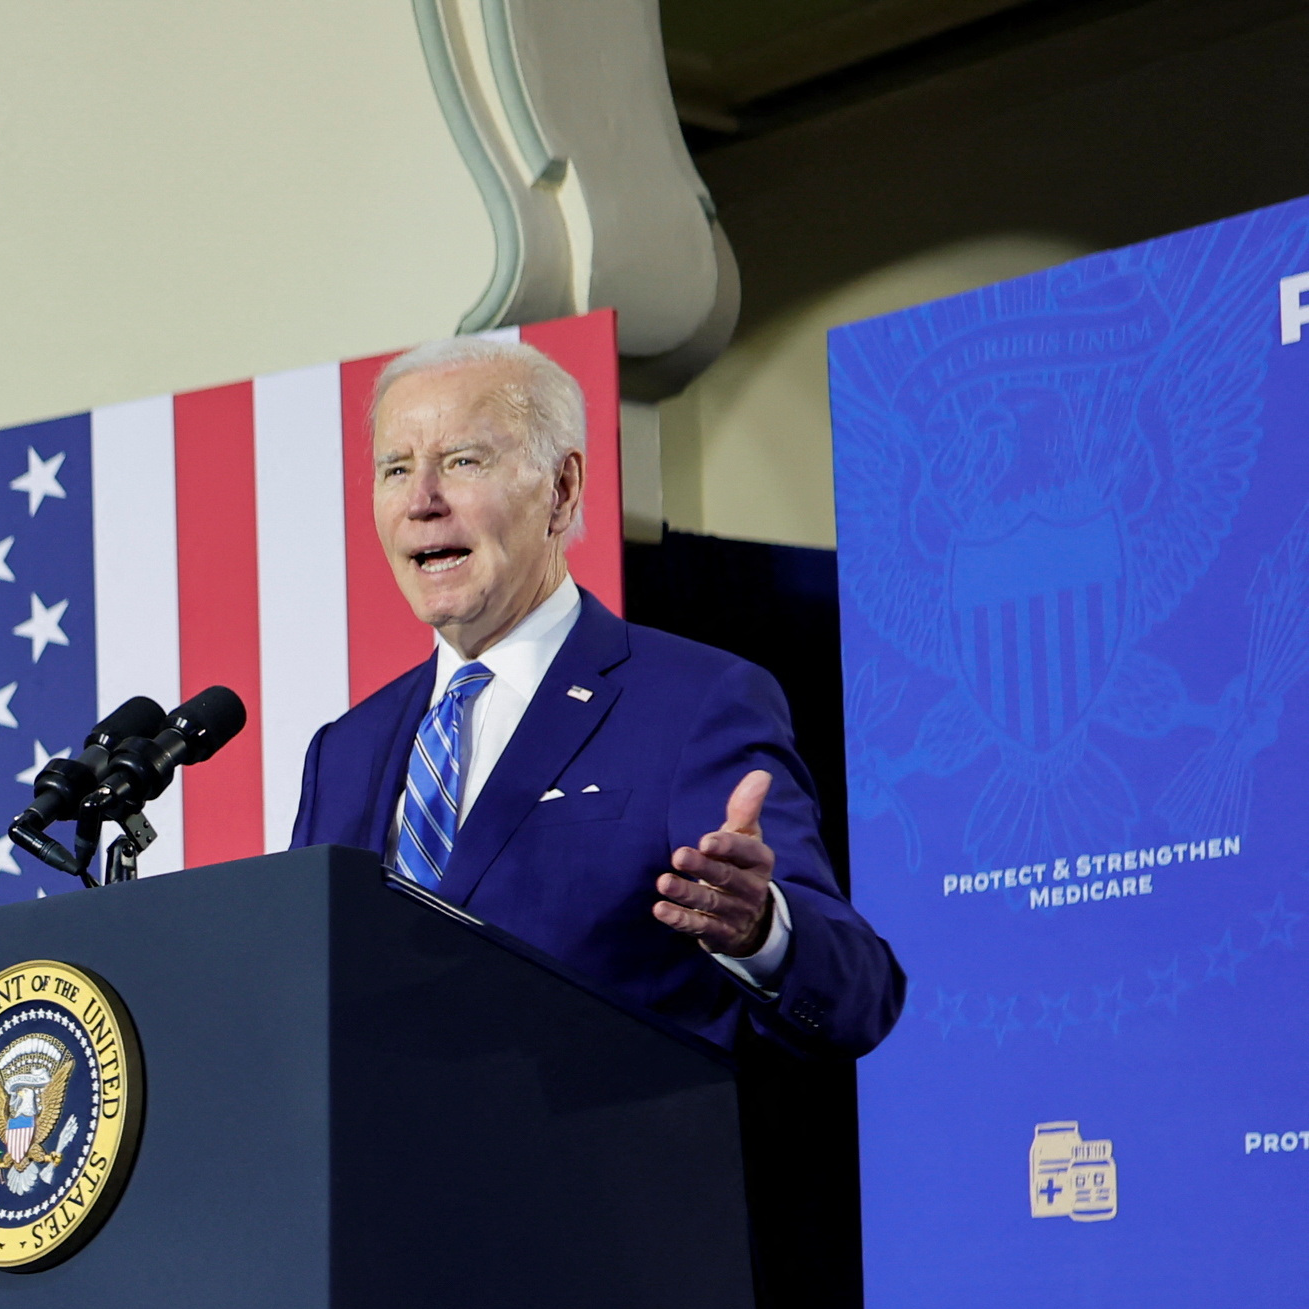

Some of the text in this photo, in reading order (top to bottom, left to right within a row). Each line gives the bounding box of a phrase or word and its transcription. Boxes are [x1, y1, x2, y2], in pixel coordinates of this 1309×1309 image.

[943, 835, 1242, 897] PROTECT & STRENGTHEN
[1029, 874, 1154, 910] MEDICARE
[31, 974, 51, 992] OF
[54, 976, 81, 1003] THE
[81, 996, 121, 1120] UNITED
[31, 1151, 108, 1250] STATES
